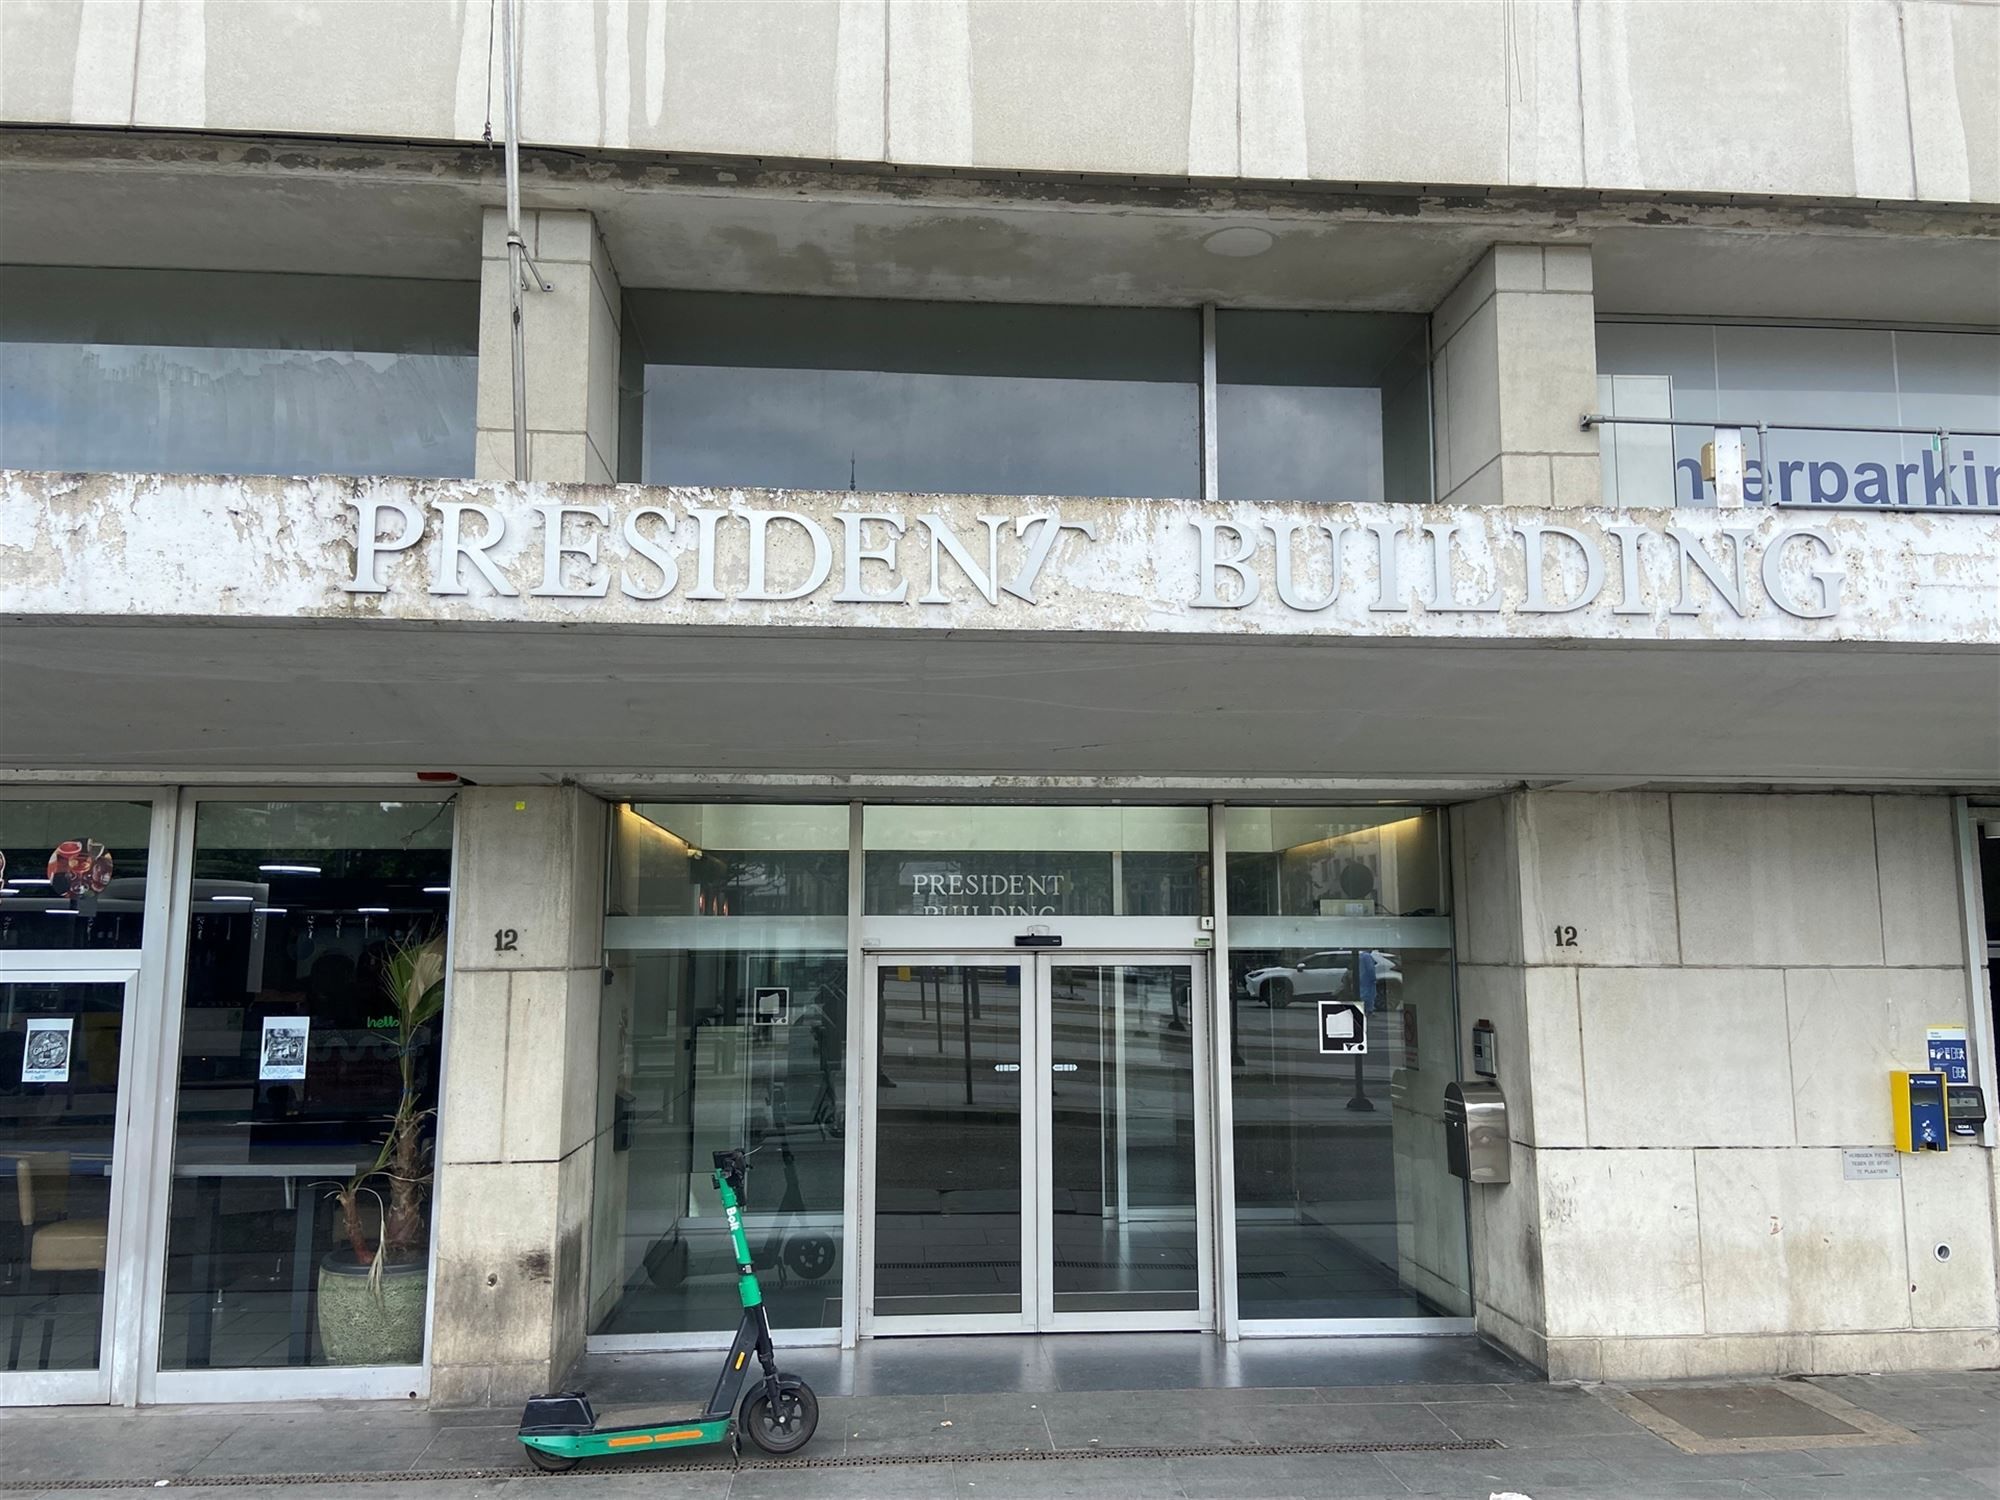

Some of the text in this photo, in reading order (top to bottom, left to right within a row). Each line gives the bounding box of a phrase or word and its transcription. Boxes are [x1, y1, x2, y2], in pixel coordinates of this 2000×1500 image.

[1676, 449, 2000, 507] nerparki
[343, 499, 1846, 619] PRESIDENT BUILDING
[912, 874, 1064, 896] PRESIDENT
[494, 929, 518, 951] 12
[1554, 925, 1578, 947] 12
[367, 1015, 400, 1028] hello
[726, 1206, 740, 1232] Bolt
